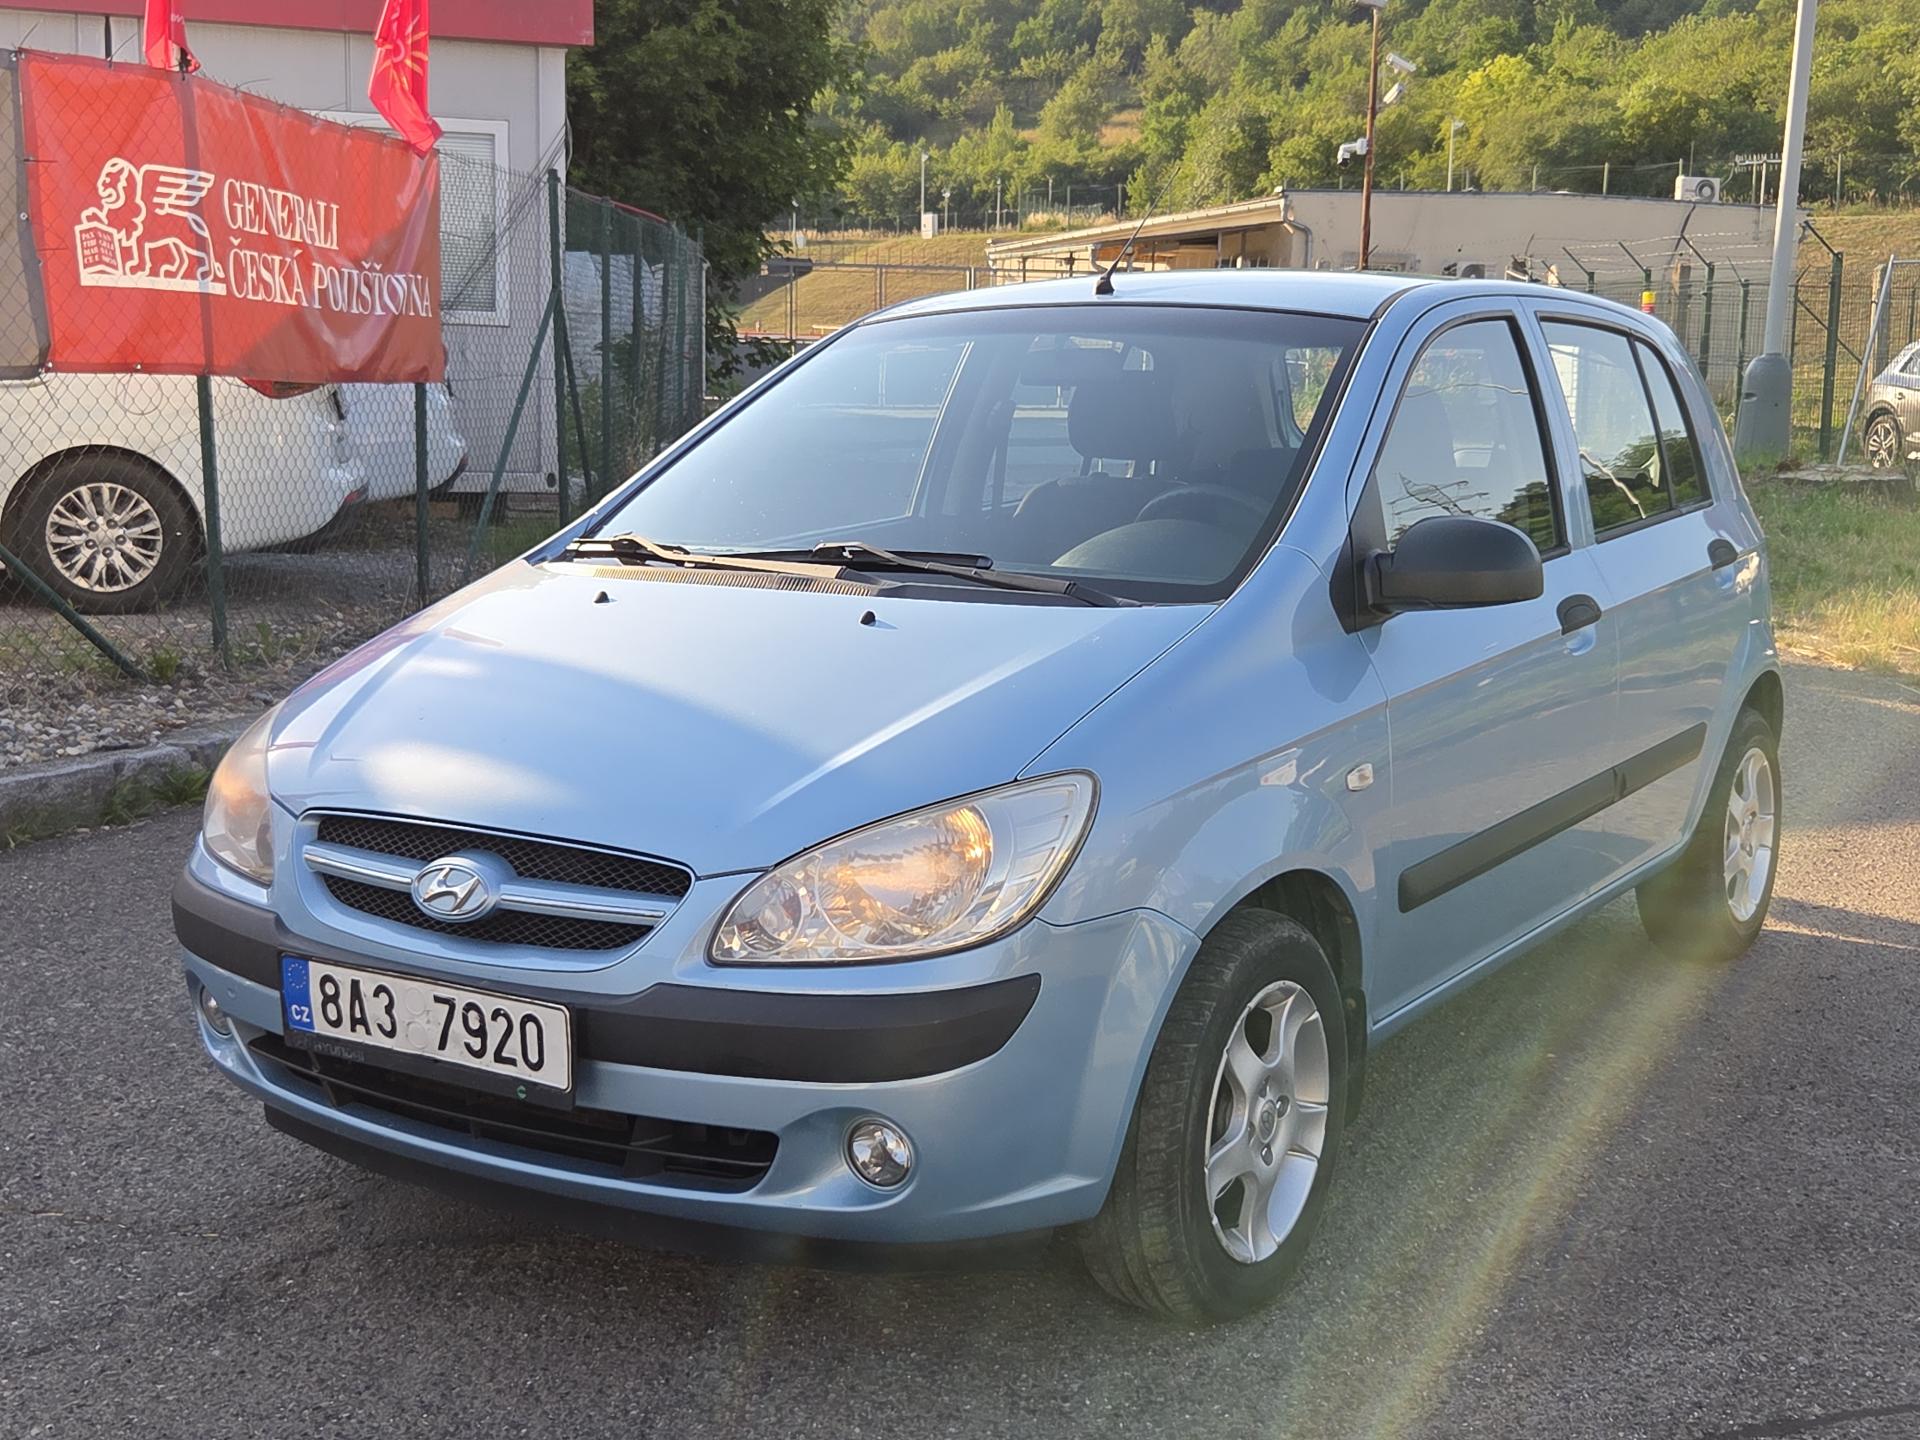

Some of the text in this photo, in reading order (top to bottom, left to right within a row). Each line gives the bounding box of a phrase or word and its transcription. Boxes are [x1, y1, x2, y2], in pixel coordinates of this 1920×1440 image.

[223, 178, 340, 250] GENERALI
[229, 236, 433, 318] ČESKÁ POJIŠŤOVNA
[291, 1004, 311, 1023] CZ
[319, 973, 545, 1072] 8A3 7920
